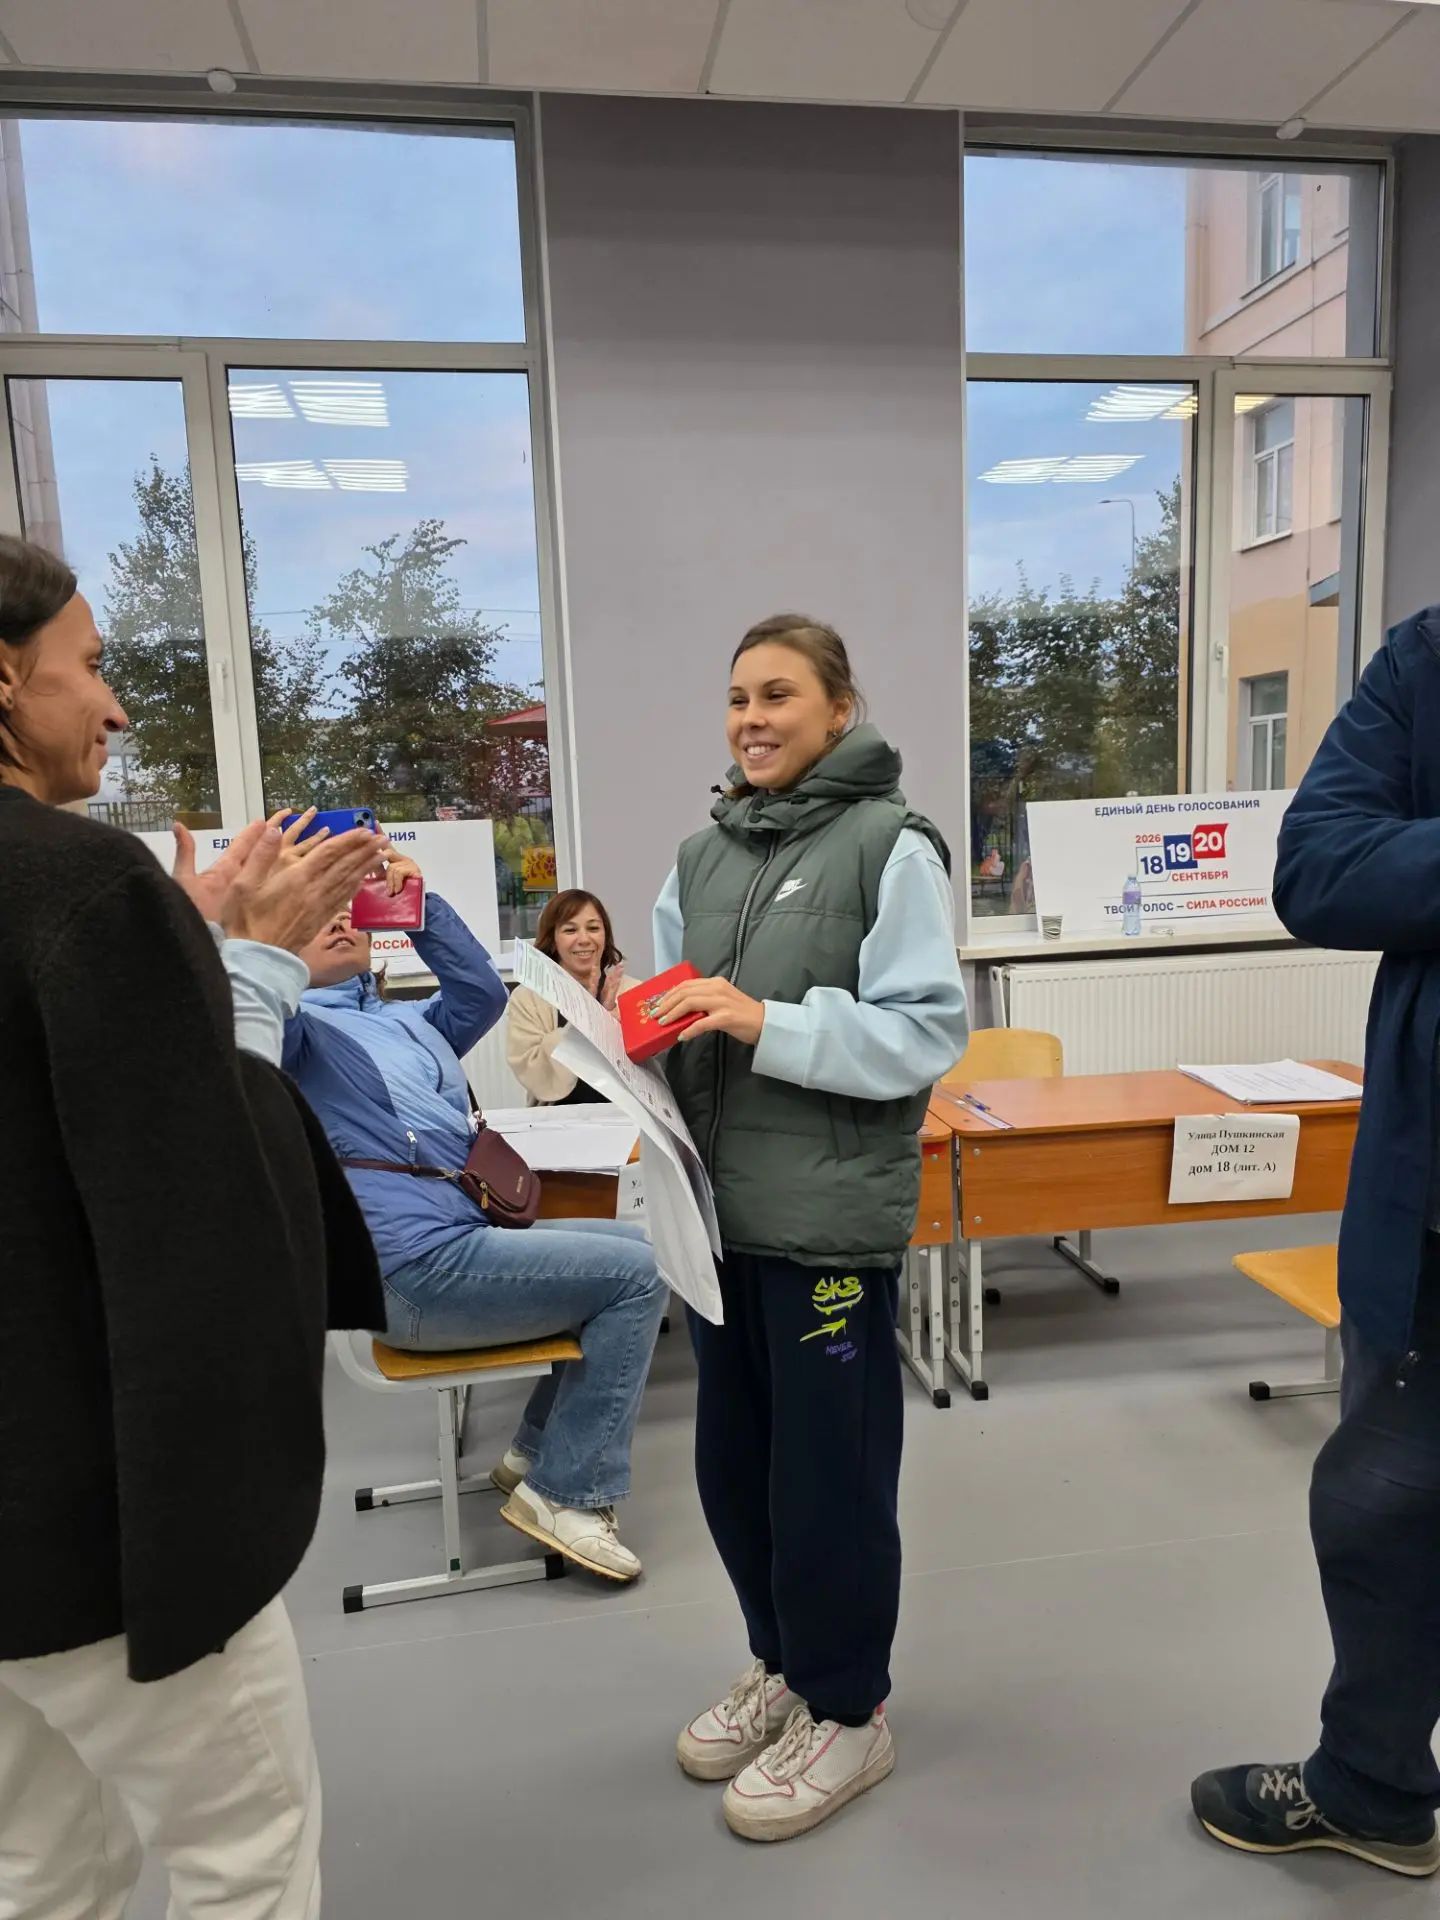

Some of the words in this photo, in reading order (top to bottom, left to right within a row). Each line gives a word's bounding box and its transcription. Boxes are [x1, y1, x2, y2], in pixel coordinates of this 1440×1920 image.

[1095, 803, 1144, 817] ЕДИНЫЙ
[1146, 804, 1175, 815] ДЕНЬ
[1178, 799, 1261, 811] ГОЛОСОВАНИЯ
[1136, 834, 1161, 844] 2026
[1140, 855, 1164, 875] 18
[1166, 843, 1191, 863] 19
[1193, 831, 1223, 852] 20
[1171, 870, 1229, 881] СЕНТЯБРЯ
[1186, 900, 1217, 910] СИЛА
[1187, 1131, 1217, 1140] Улица
[1219, 1129, 1285, 1140] Пушкинская
[1211, 1144, 1239, 1156] ДОМ
[1243, 1144, 1255, 1153] 12
[1217, 1160, 1230, 1173] 18
[1233, 1162, 1260, 1174] (лит.
[1263, 1161, 1276, 1173] А)
